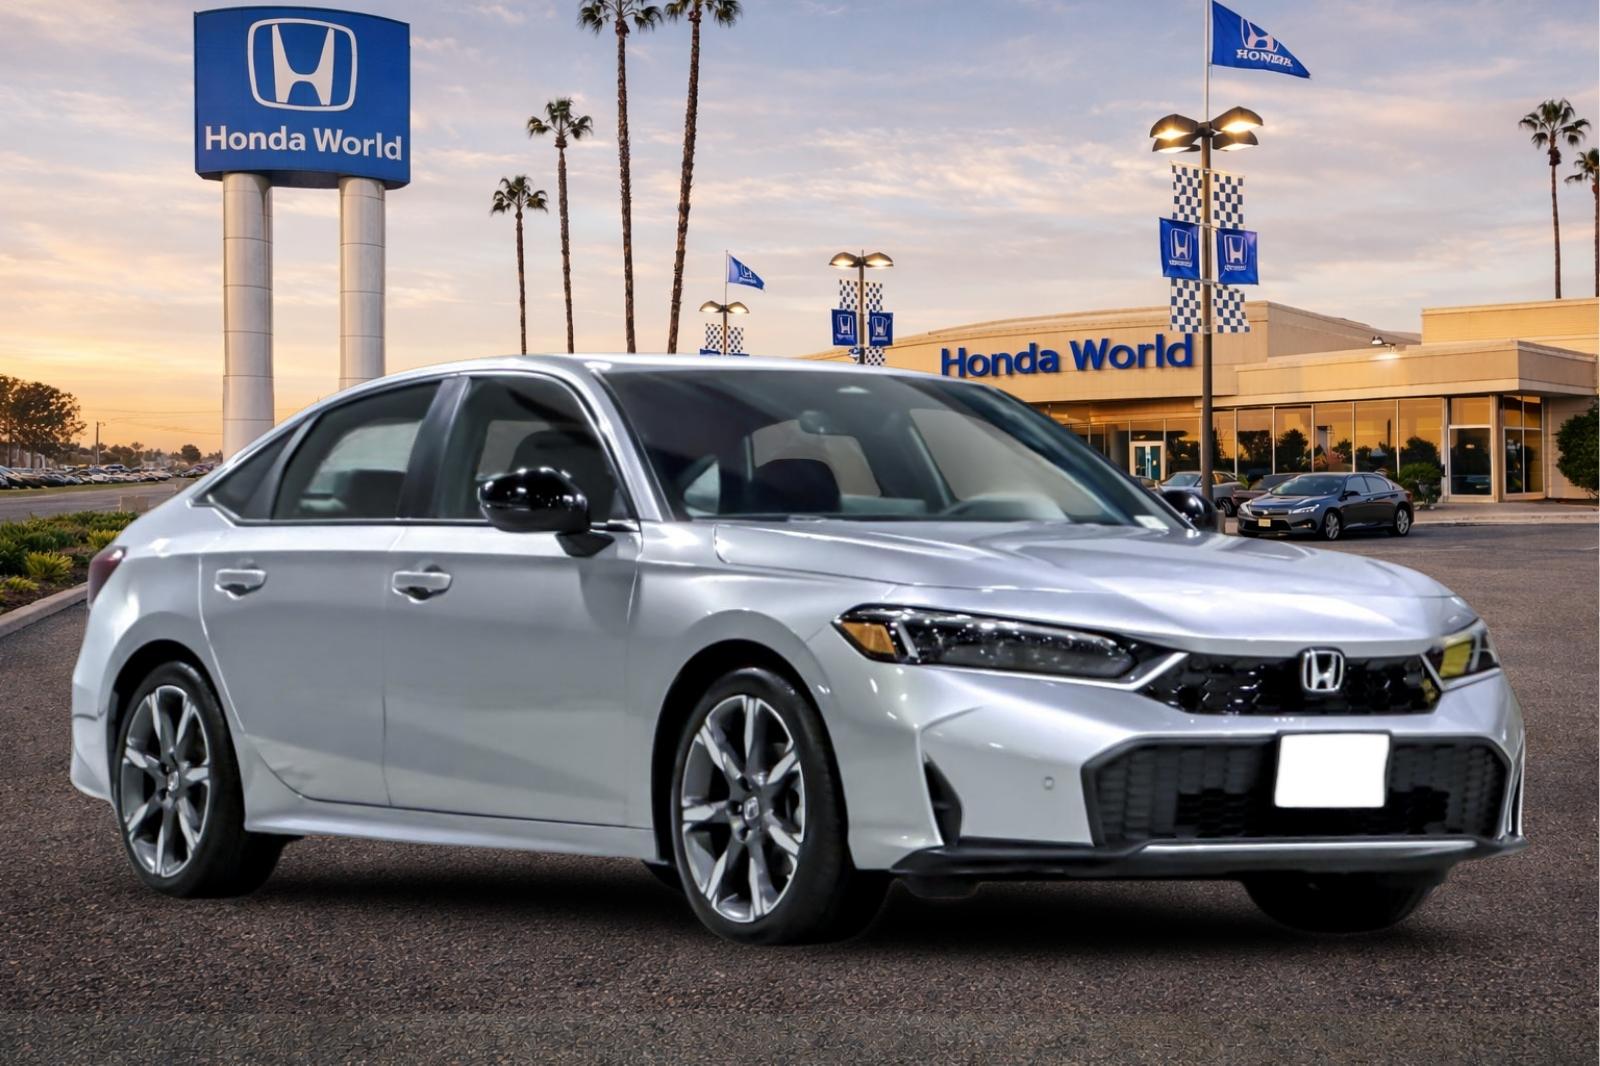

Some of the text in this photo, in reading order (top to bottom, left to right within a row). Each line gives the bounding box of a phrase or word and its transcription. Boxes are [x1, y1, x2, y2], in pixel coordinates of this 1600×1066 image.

[205, 125, 402, 161] Honda World
[941, 333, 1193, 377] Honda World
